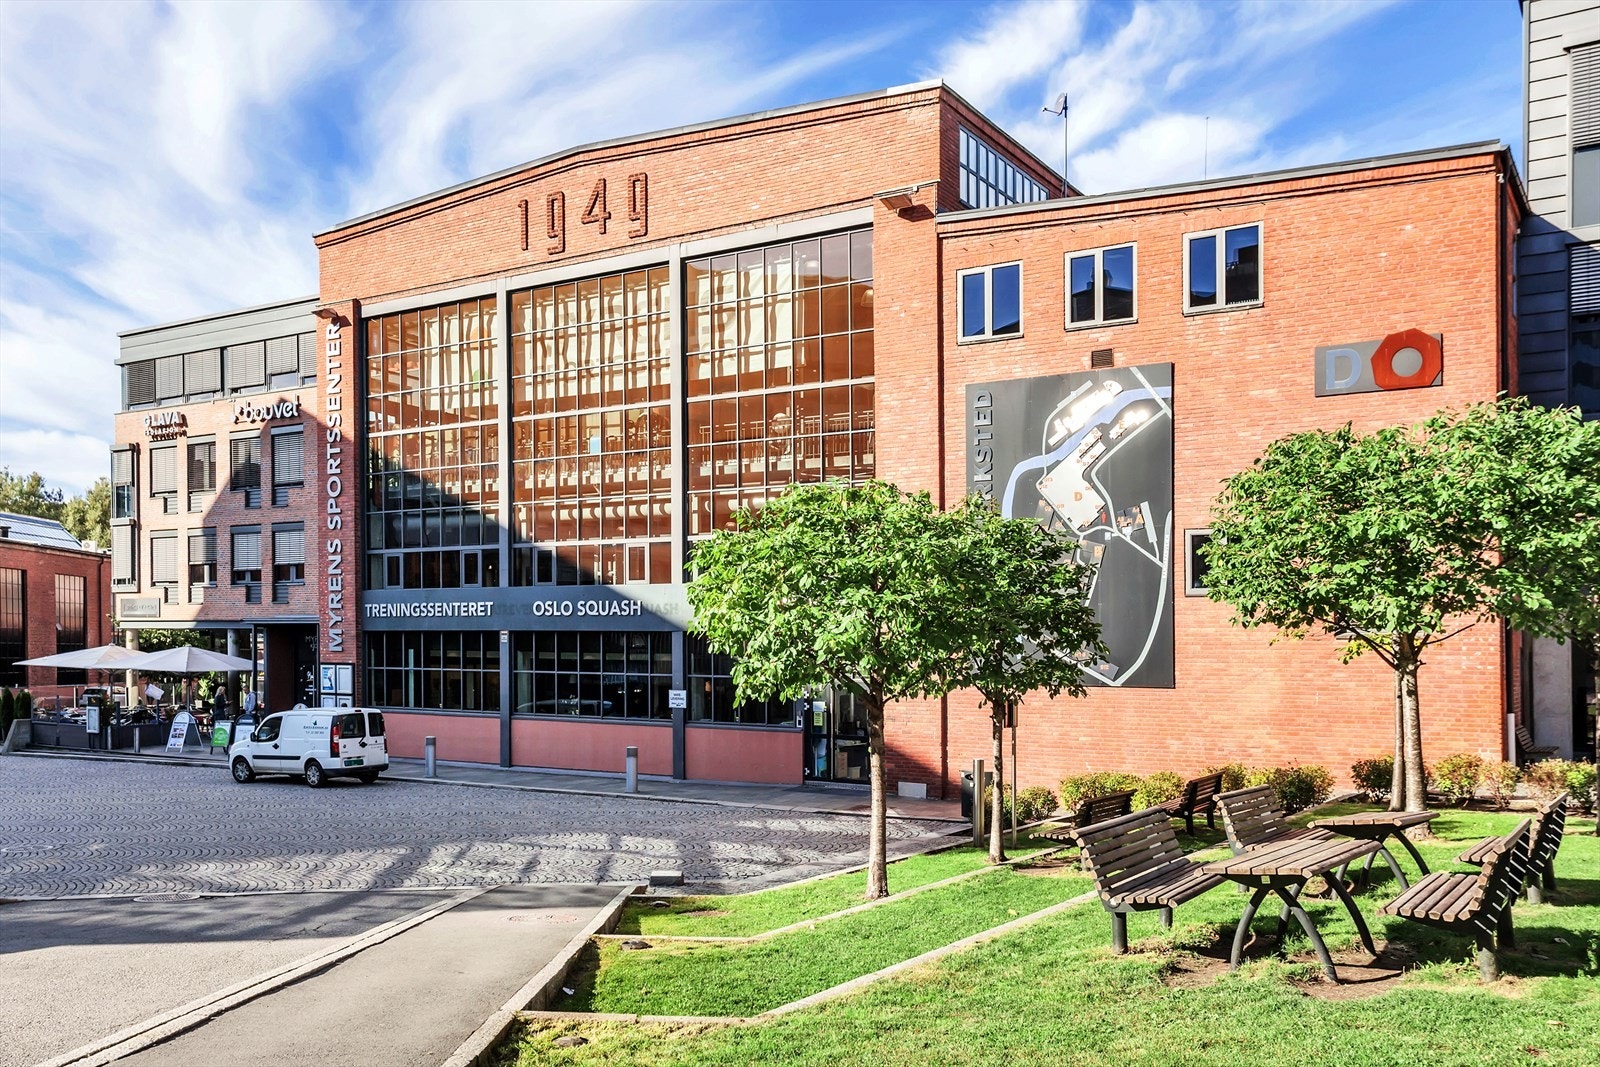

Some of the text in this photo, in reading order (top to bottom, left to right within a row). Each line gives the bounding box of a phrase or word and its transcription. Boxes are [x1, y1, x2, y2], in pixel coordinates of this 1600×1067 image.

[517, 172, 649, 256] 1949
[143, 410, 182, 428] GLAVA
[244, 398, 299, 422] bouvet
[325, 321, 343, 532] SPORTSSENTER
[973, 388, 994, 508] RKSTED
[326, 537, 344, 653] MYRENS
[364, 600, 494, 618] TRENINGSSENTERET
[532, 600, 573, 616] OSLO
[577, 599, 642, 616] SQUASH
